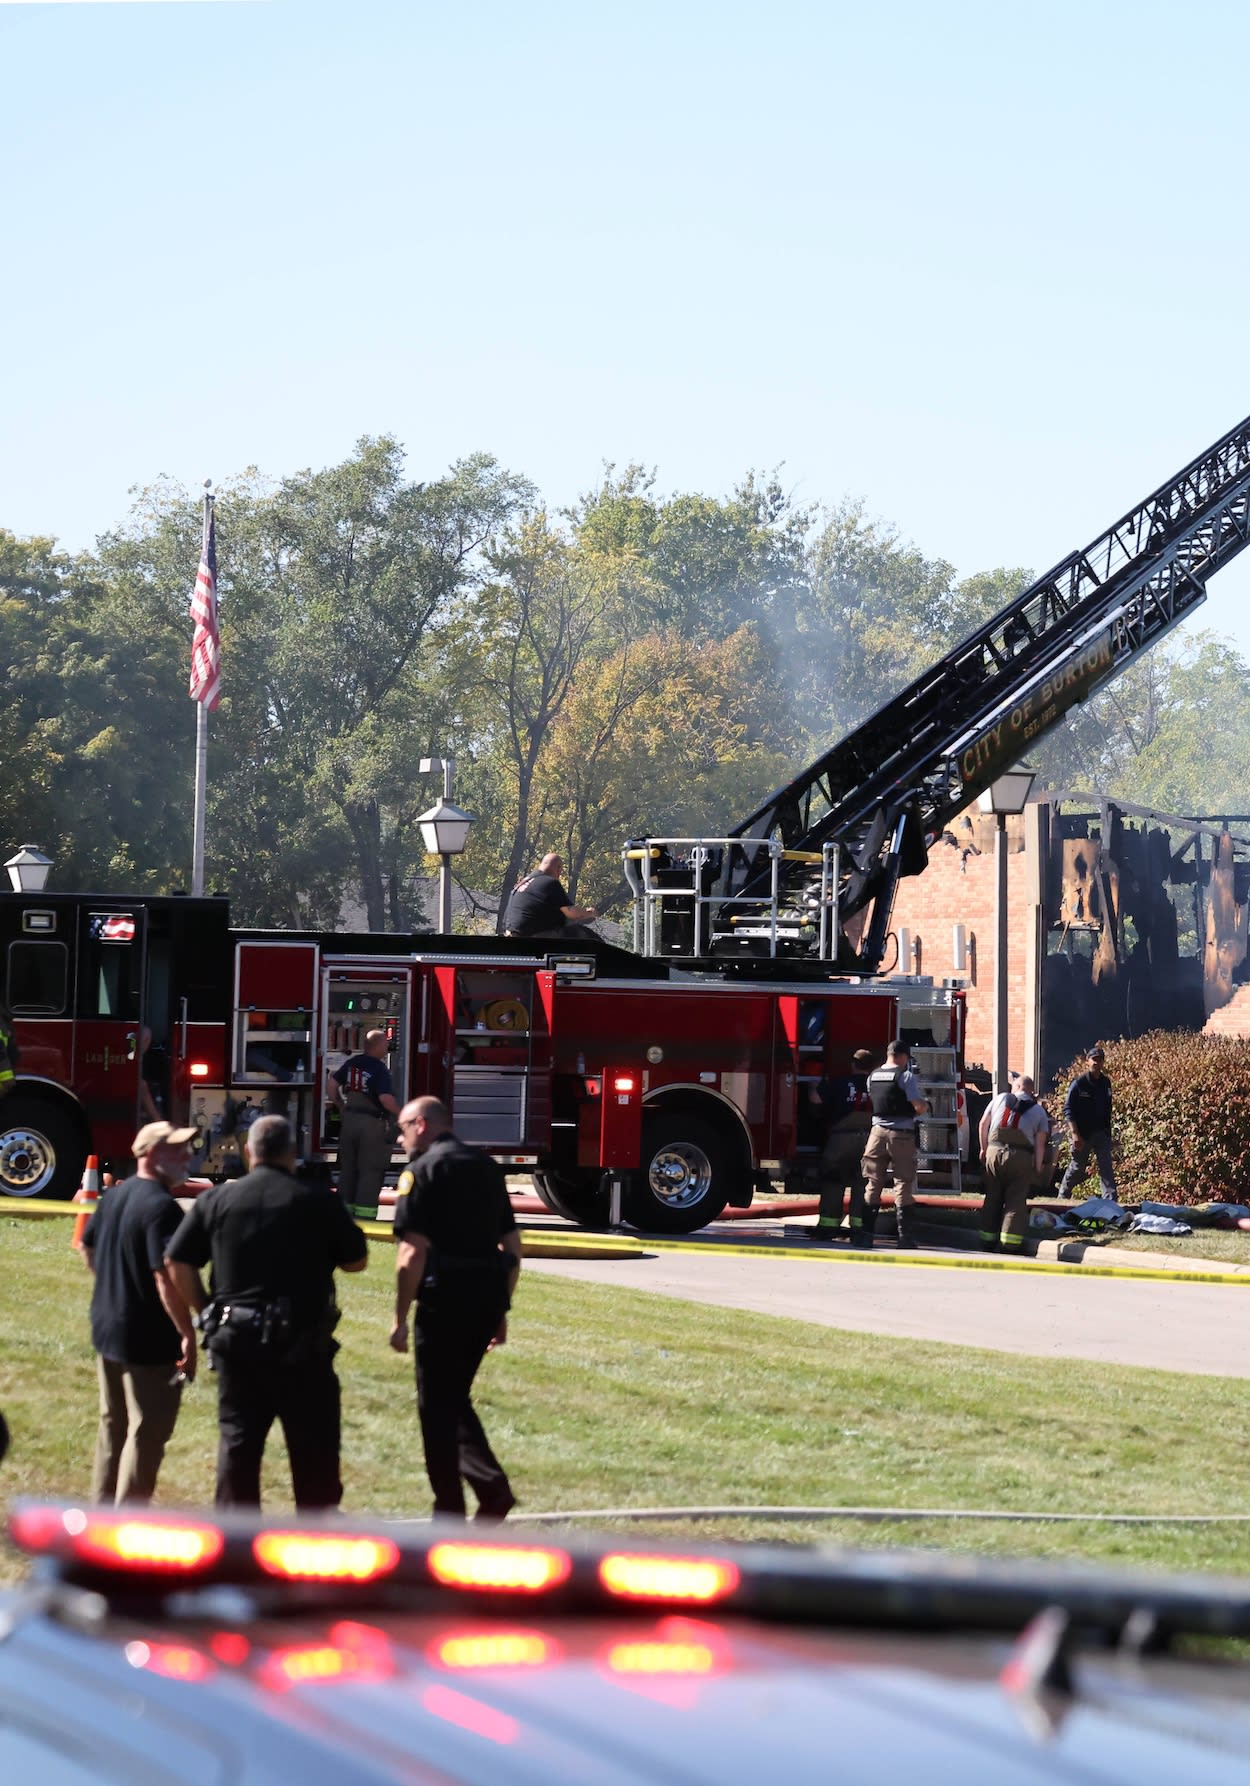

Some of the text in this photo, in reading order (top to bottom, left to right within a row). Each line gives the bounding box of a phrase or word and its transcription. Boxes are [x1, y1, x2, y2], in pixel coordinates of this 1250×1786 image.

[963, 638, 1112, 779] CITY OF BURTON
